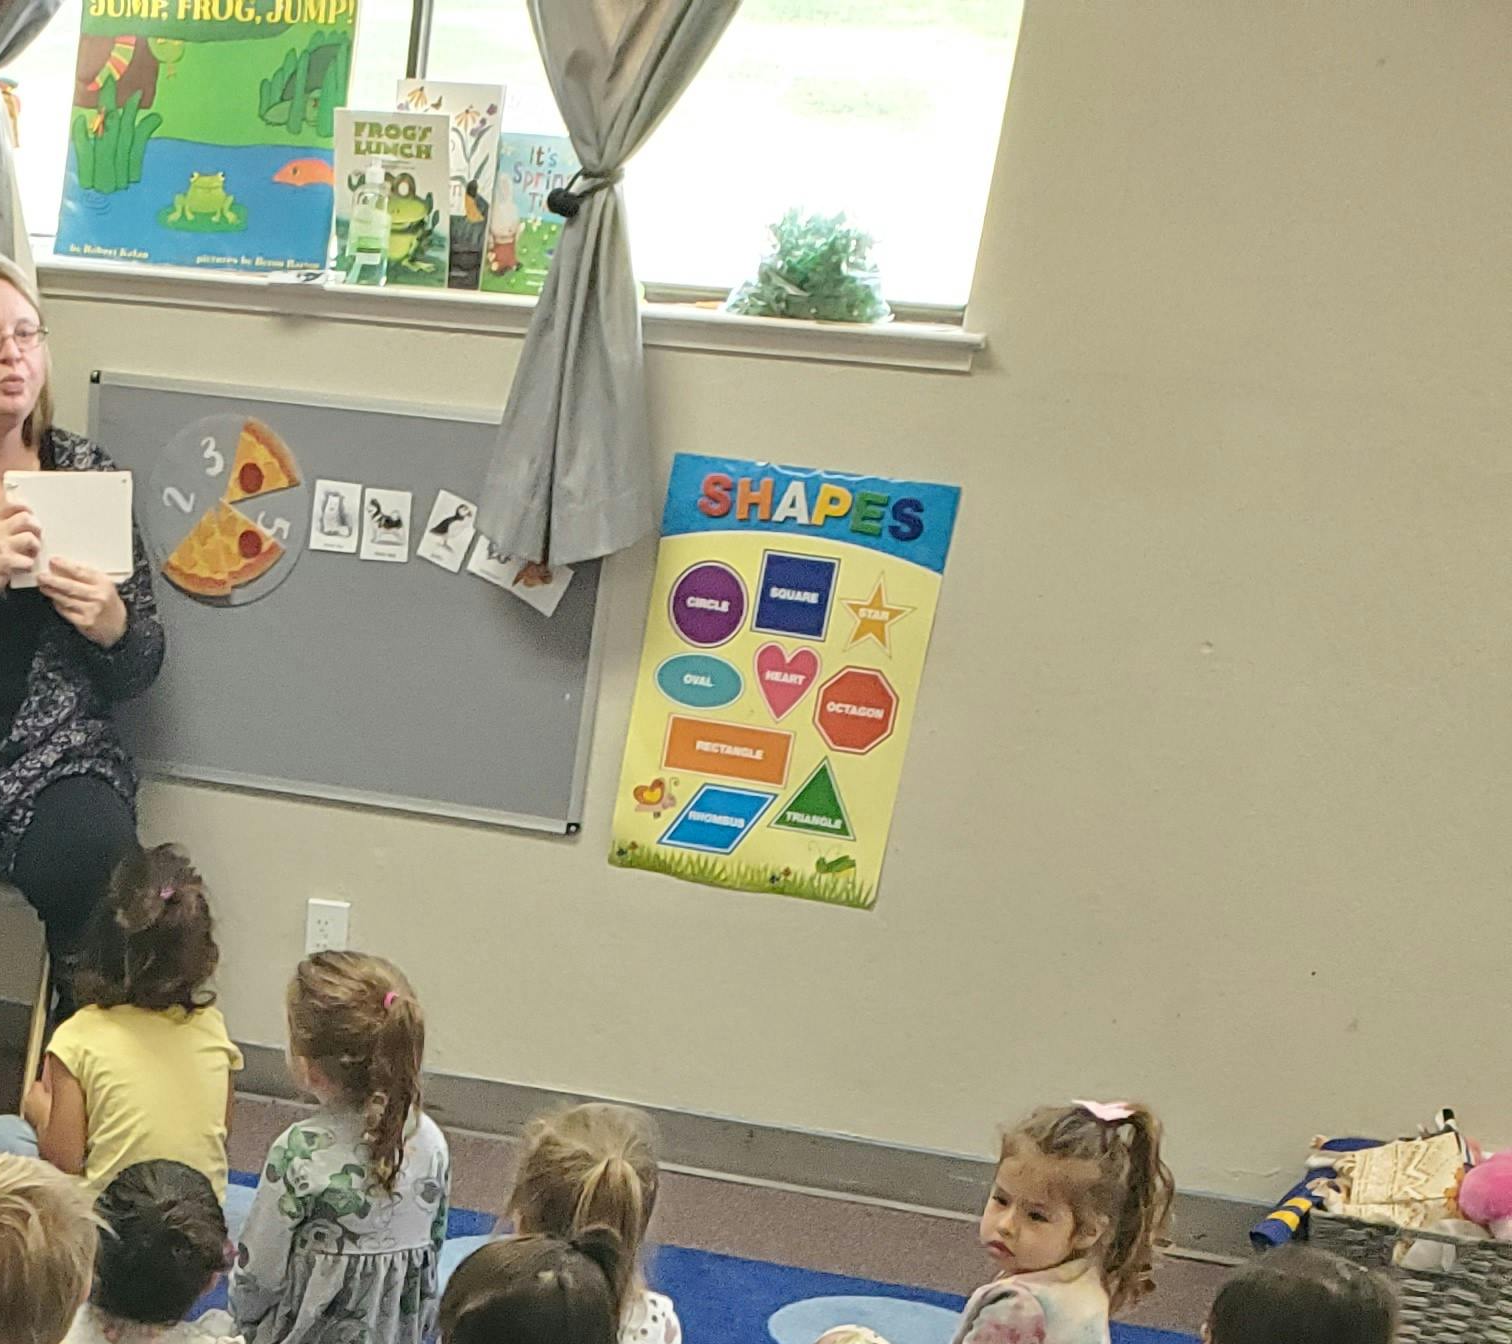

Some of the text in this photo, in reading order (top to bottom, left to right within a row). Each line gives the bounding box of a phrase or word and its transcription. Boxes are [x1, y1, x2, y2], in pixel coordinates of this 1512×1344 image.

[89, 0, 354, 25] JUMP, FROG, JUMP!
[354, 121, 432, 142] FROG'S
[354, 140, 432, 160] LUNCH
[529, 146, 558, 167] It's
[513, 161, 571, 191] Sprin
[201, 436, 225, 476] 3
[163, 486, 196, 514] 2
[697, 472, 925, 542] SHAPES
[256, 510, 291, 541] 5
[686, 596, 730, 613] CIRCLE
[769, 587, 819, 604] SQUARE
[858, 607, 890, 621] STAR
[683, 673, 714, 687] OVAL
[765, 670, 806, 686] HEART
[826, 701, 885, 720] OCTAGON
[695, 740, 765, 761] RECTANGLE
[688, 810, 746, 829] RHOMBUS
[785, 810, 844, 830] TRIANGLE
